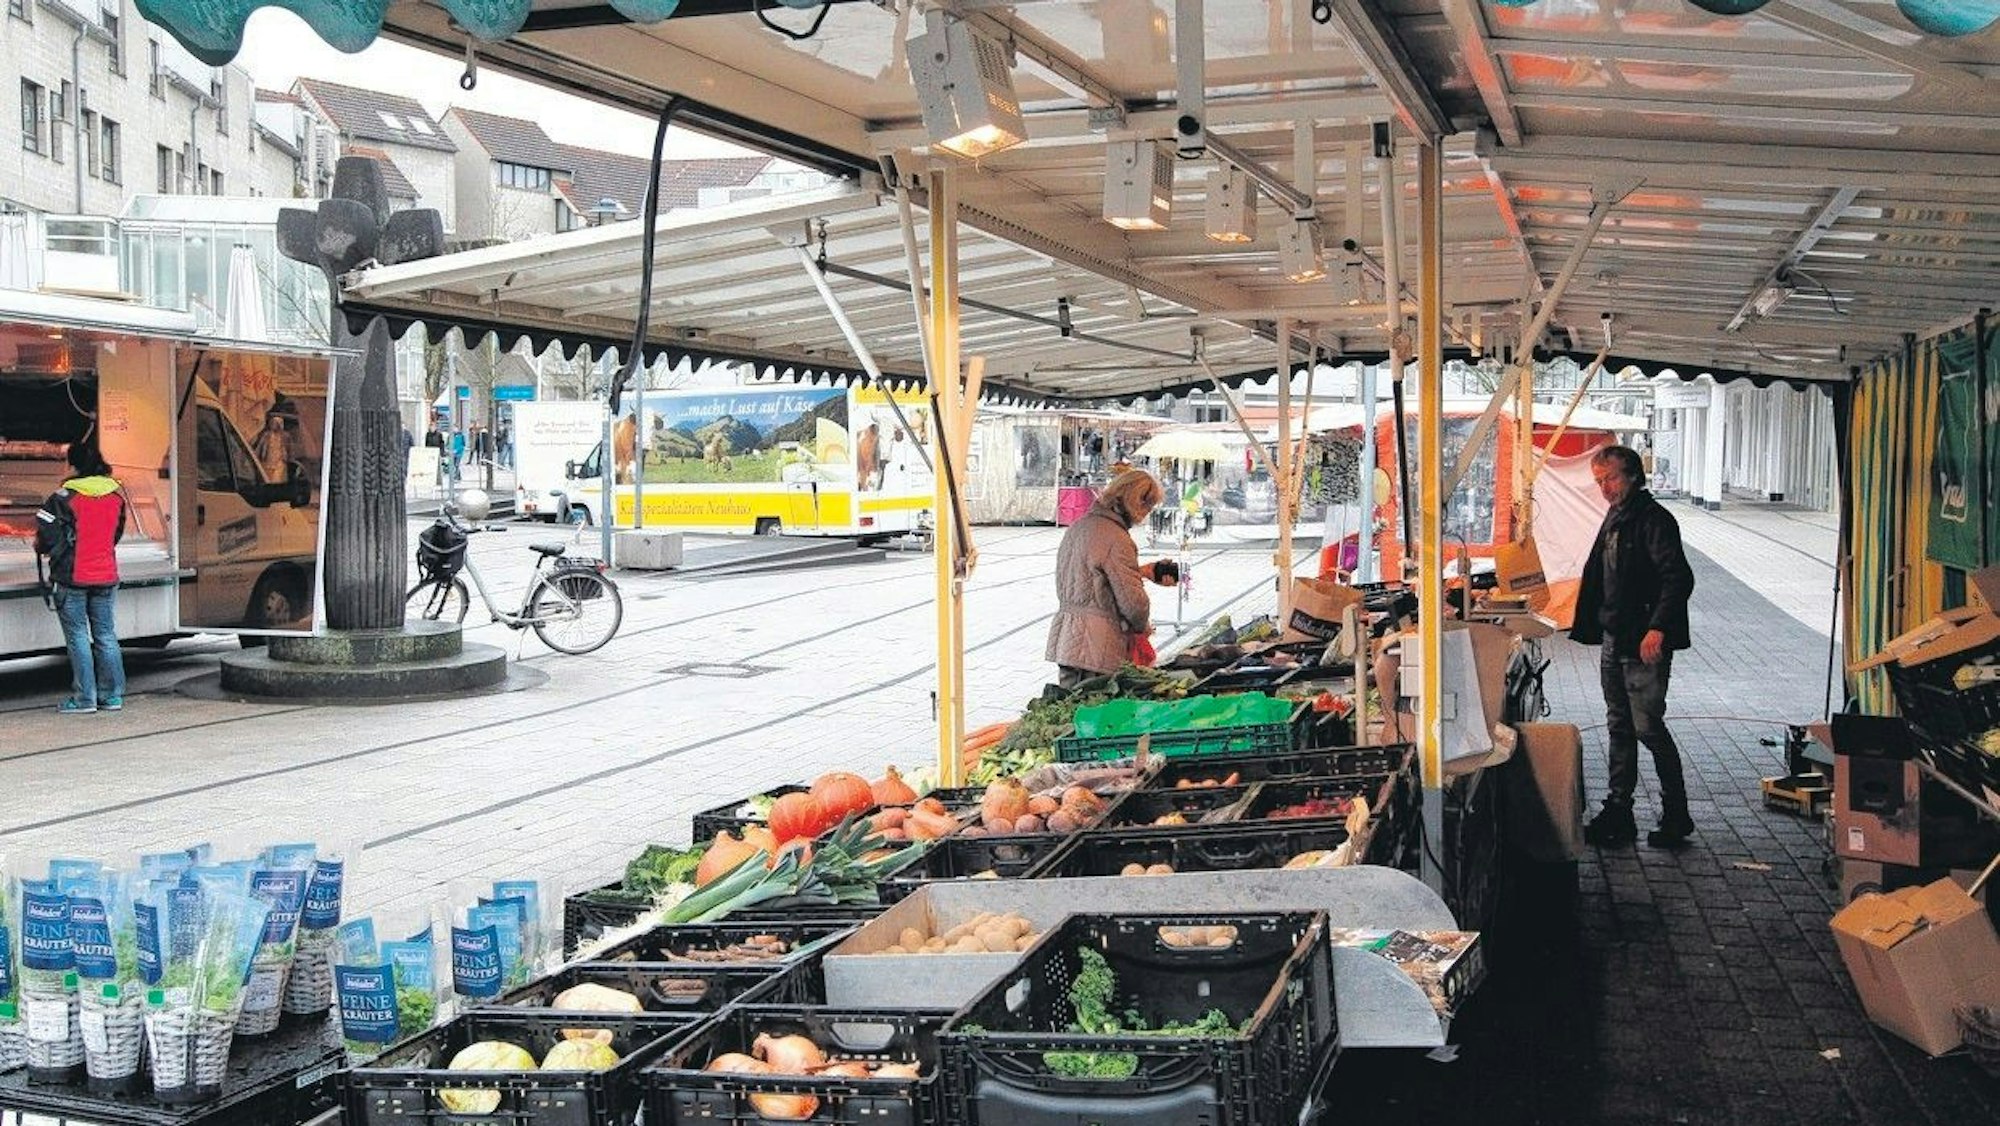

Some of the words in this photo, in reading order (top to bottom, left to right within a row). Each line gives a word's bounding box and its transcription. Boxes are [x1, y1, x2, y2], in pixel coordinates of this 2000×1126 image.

[729, 398, 756, 415] Lust
[759, 395, 781, 420] auf
[783, 395, 815, 412] Käse
[453, 952, 497, 968] FEINE
[453, 966, 499, 979] KRÄUTER
[341, 994, 392, 1010] FEINE
[342, 1008, 394, 1021] KRÄUTER
